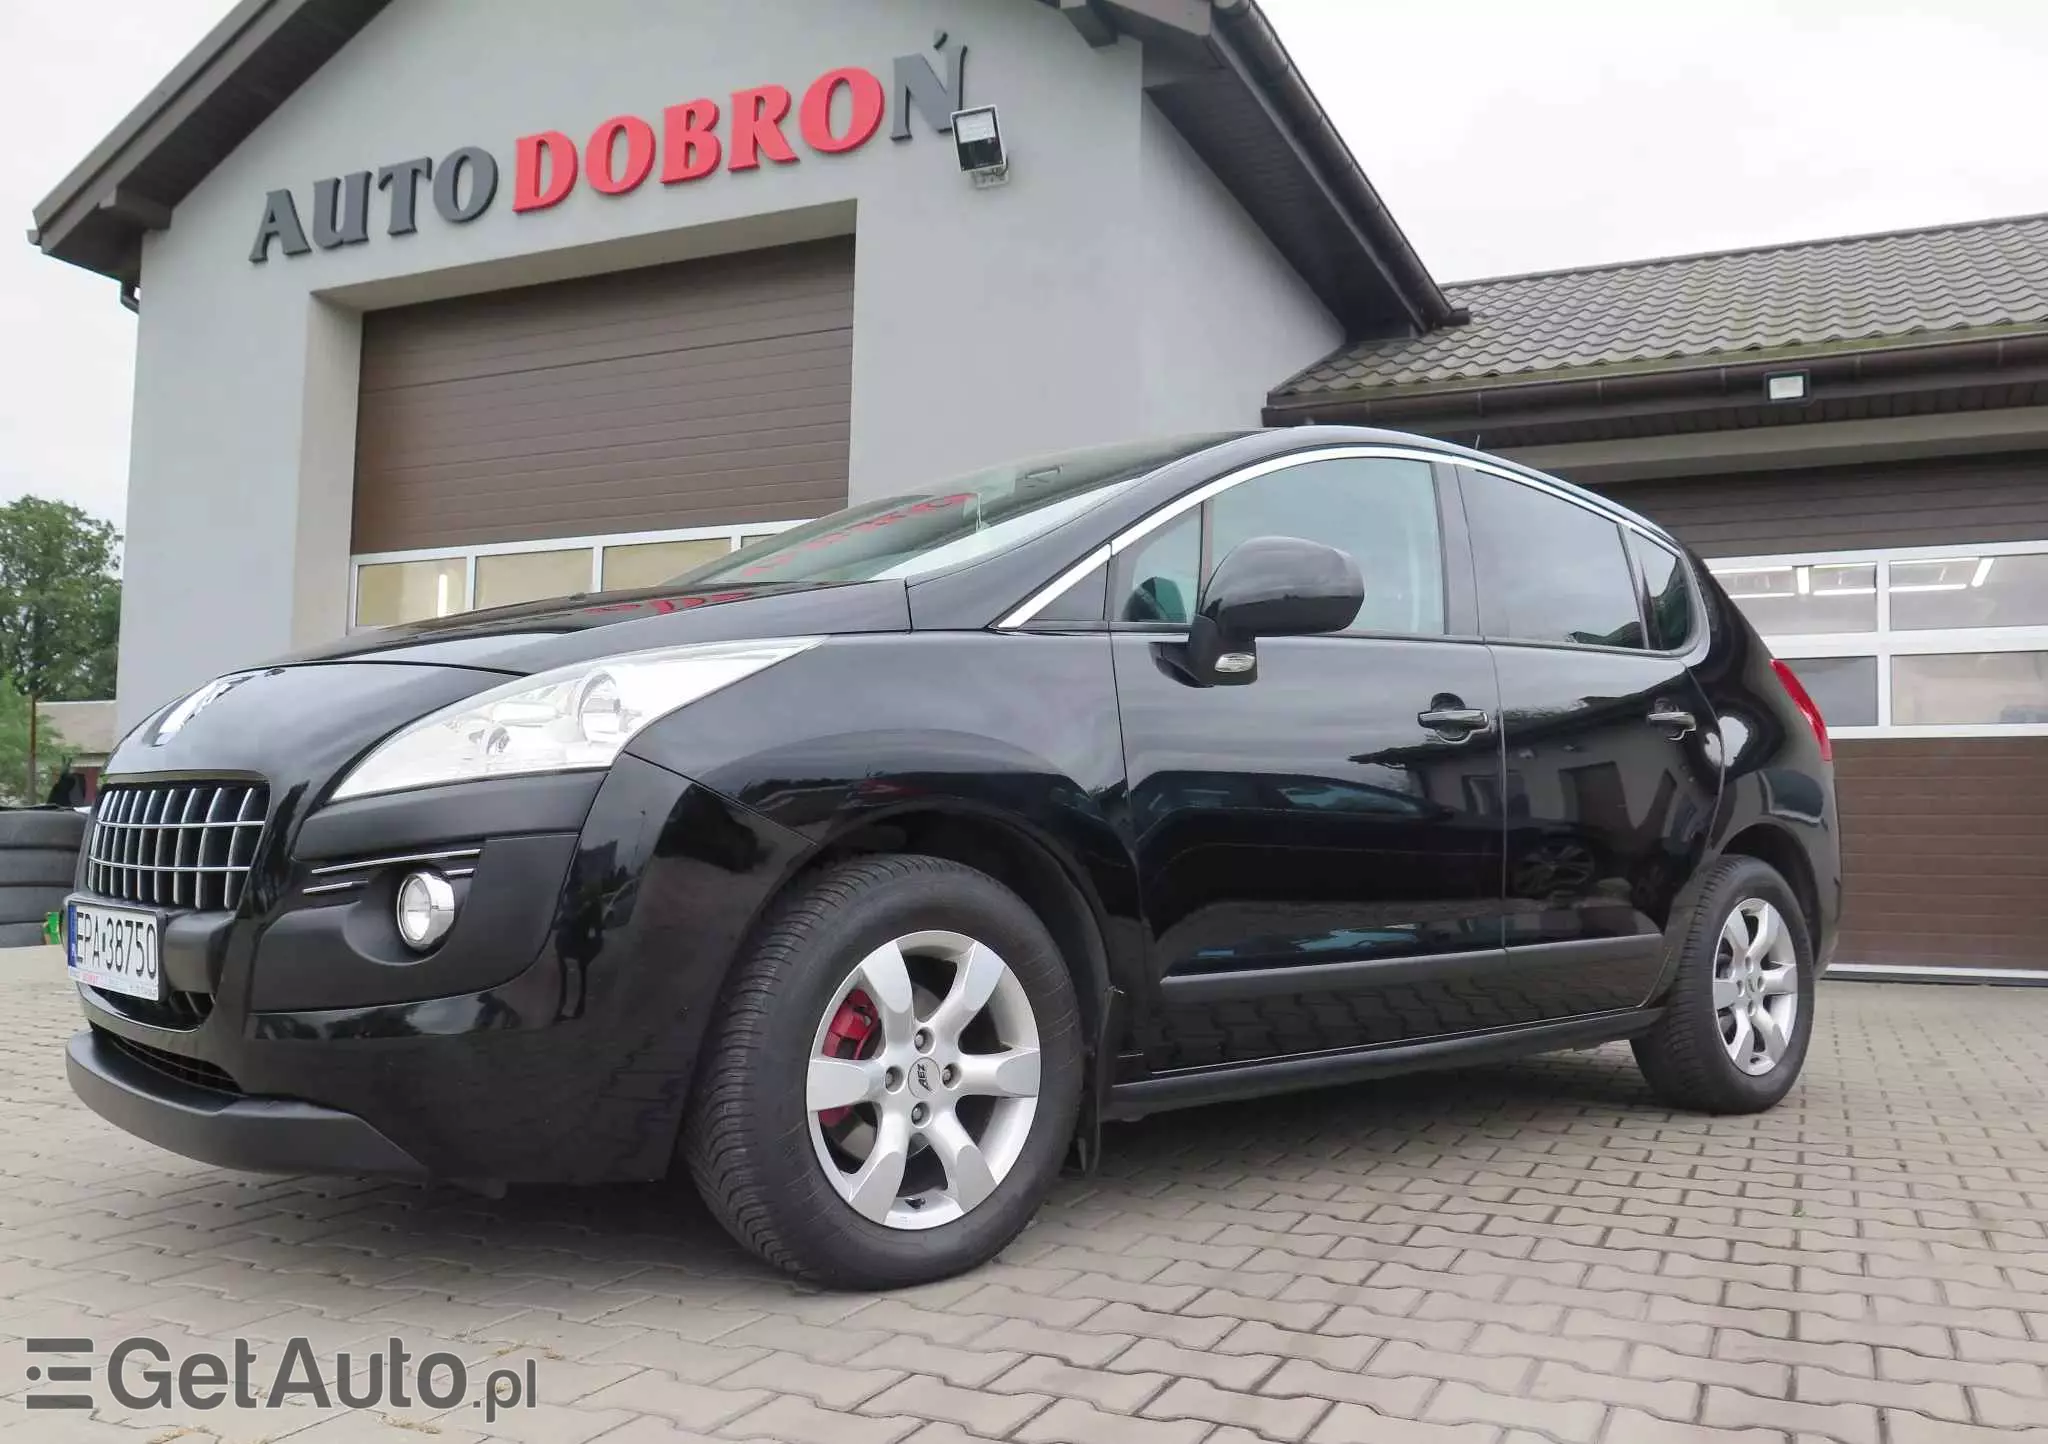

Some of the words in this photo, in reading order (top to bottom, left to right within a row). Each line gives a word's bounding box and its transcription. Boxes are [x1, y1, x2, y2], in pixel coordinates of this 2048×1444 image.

[249, 146, 499, 263] AUTO
[512, 29, 968, 213] DOBROŃ
[106, 917, 157, 980] 38750
[917, 1063, 933, 1092] AEZ
